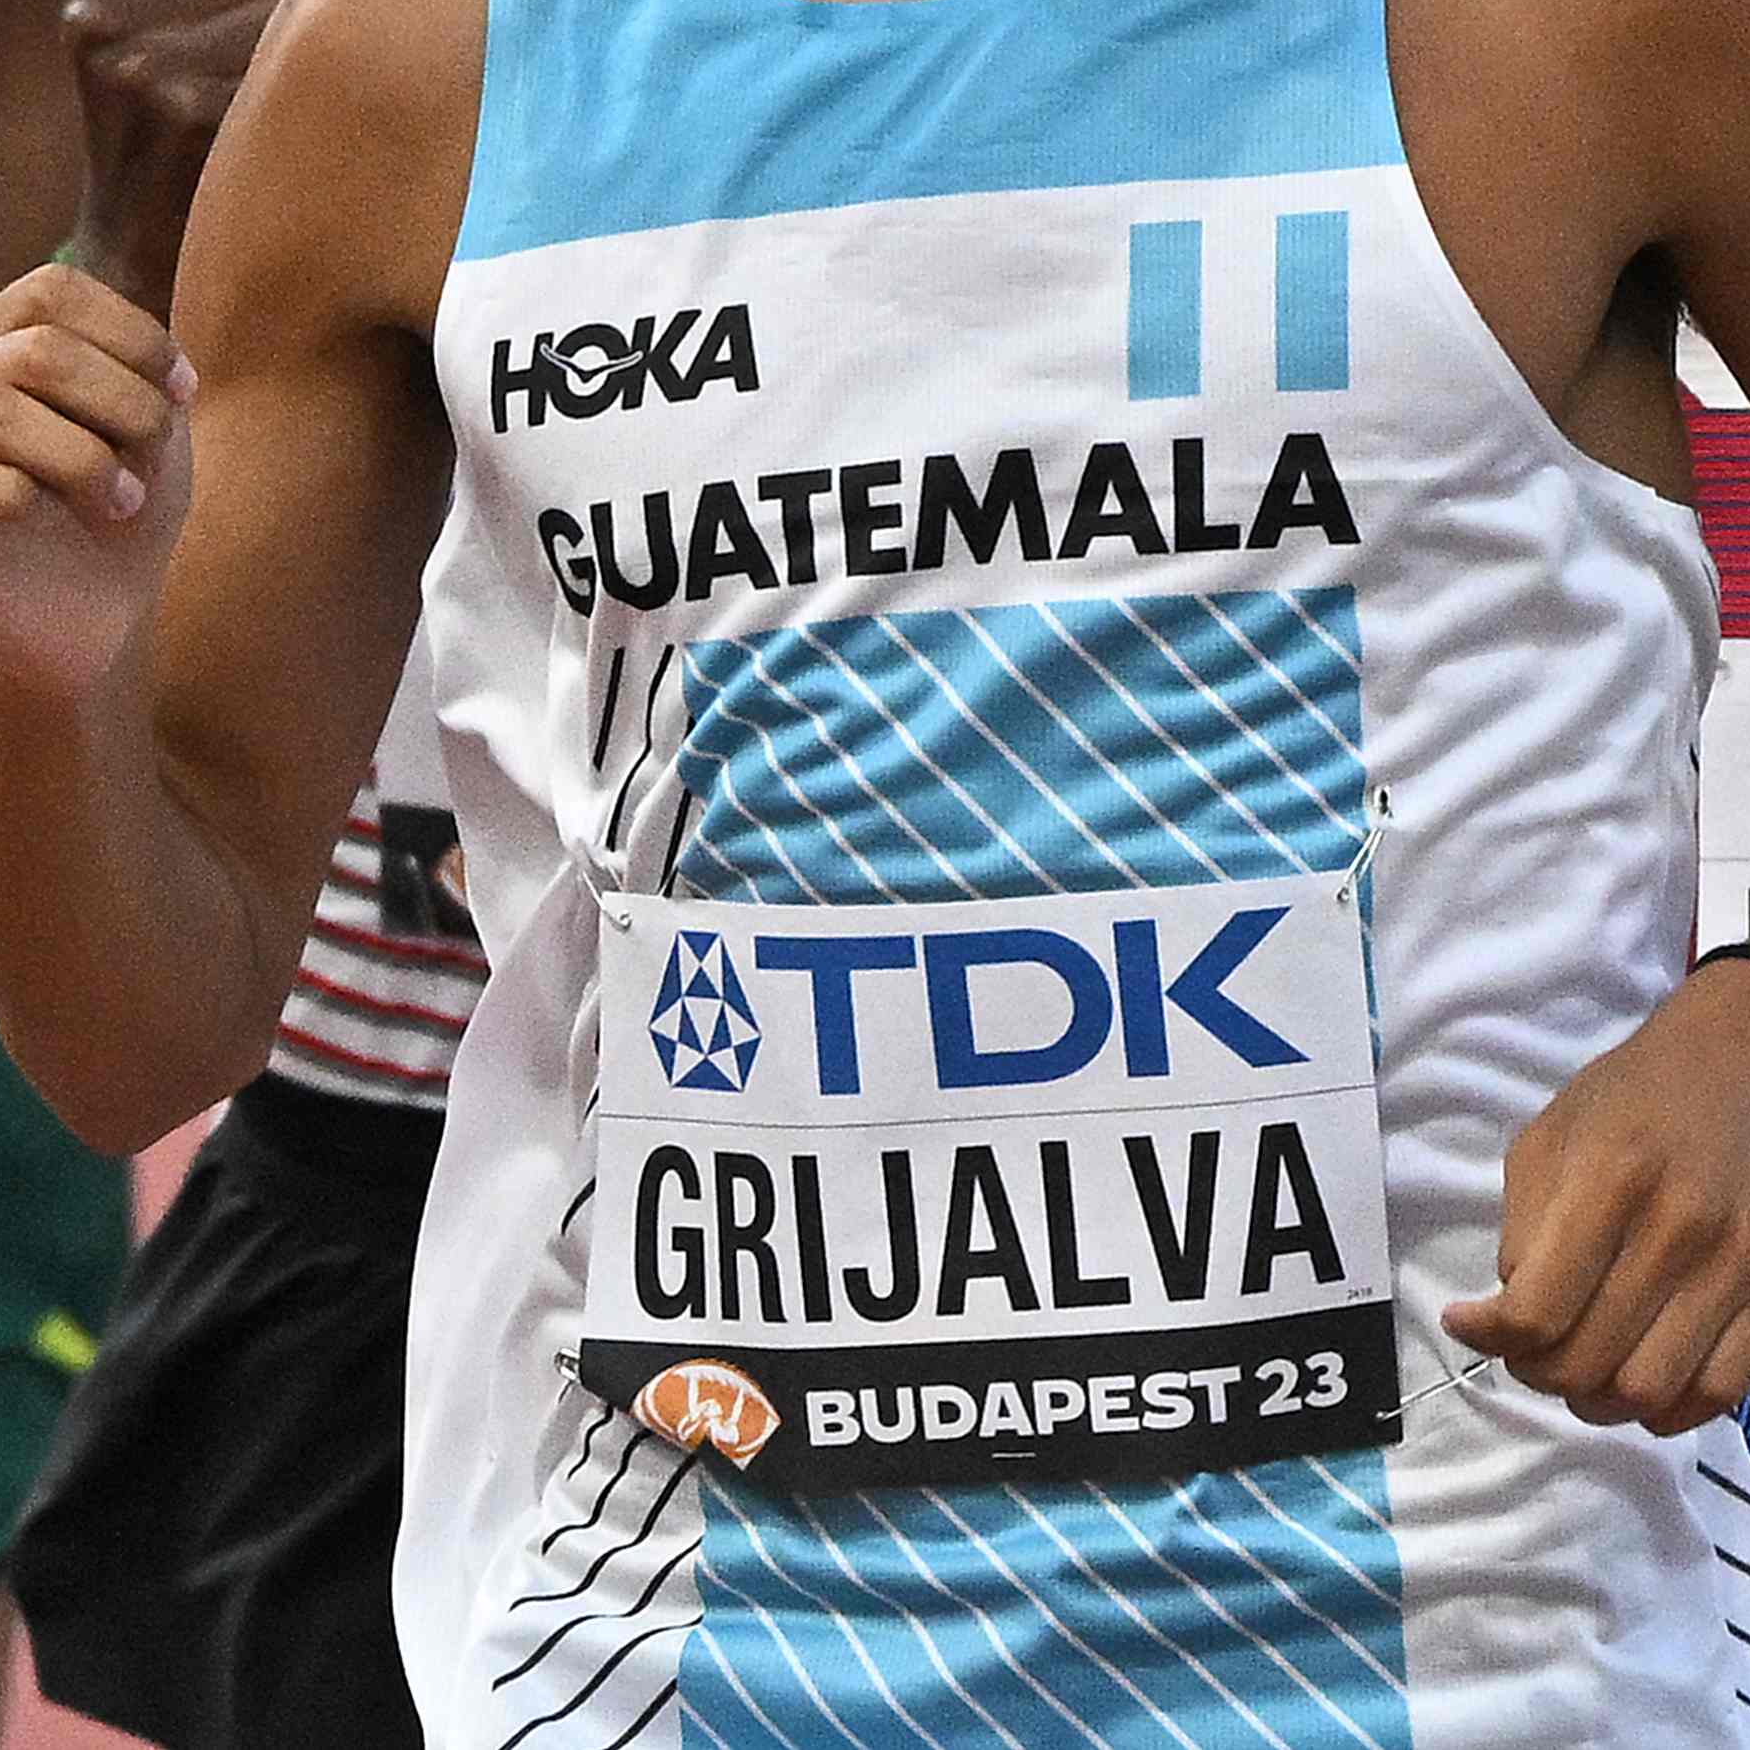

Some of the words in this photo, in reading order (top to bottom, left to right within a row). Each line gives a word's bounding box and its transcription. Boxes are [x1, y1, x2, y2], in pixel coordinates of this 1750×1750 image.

[490, 304, 759, 433] HOKA
[537, 433, 1360, 618] GUATEMALA
[754, 906, 1312, 1096] TDK
[632, 1121, 1347, 1324] GRIJALVA
[804, 1365, 1243, 1449] BUDAPEST
[1258, 1350, 1349, 1412] 23
